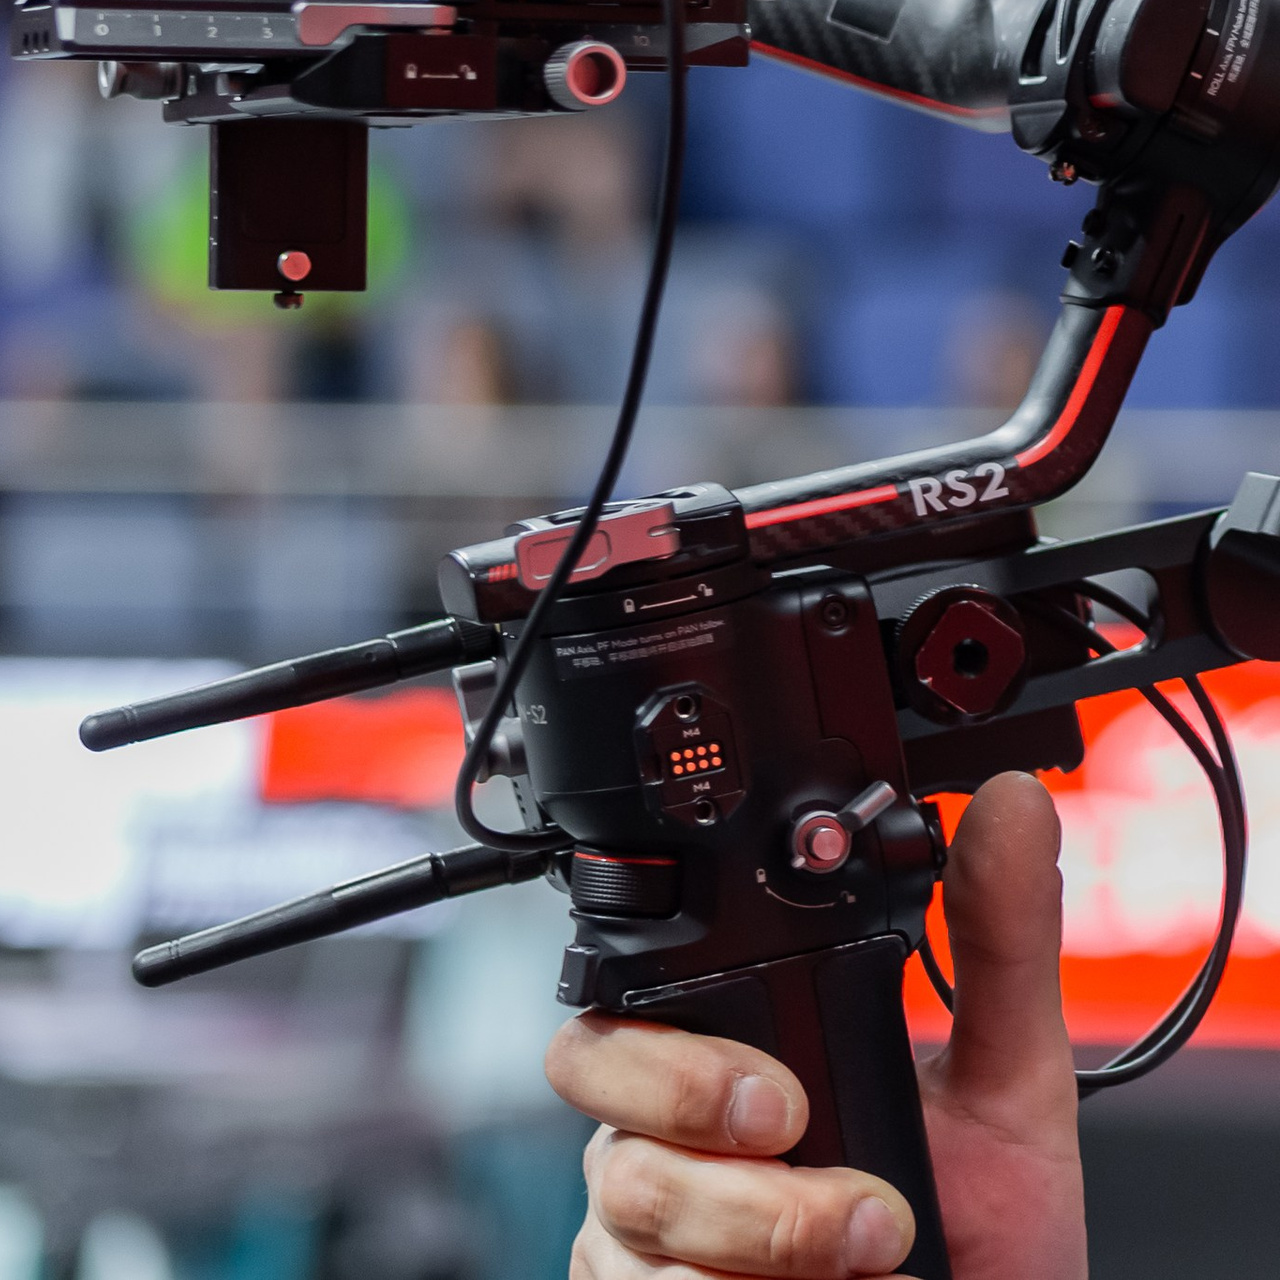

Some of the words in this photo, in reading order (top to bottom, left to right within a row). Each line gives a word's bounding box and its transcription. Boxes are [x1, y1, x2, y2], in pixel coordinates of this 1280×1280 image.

[207, 26, 218, 39] 2
[262, 27, 274, 39] 3
[908, 462, 1009, 516] RS2
[556, 647, 576, 657] PAN
[597, 640, 610, 651] PF
[677, 624, 699, 636] PAN
[682, 727, 701, 738] M4
[692, 780, 711, 792] M4
